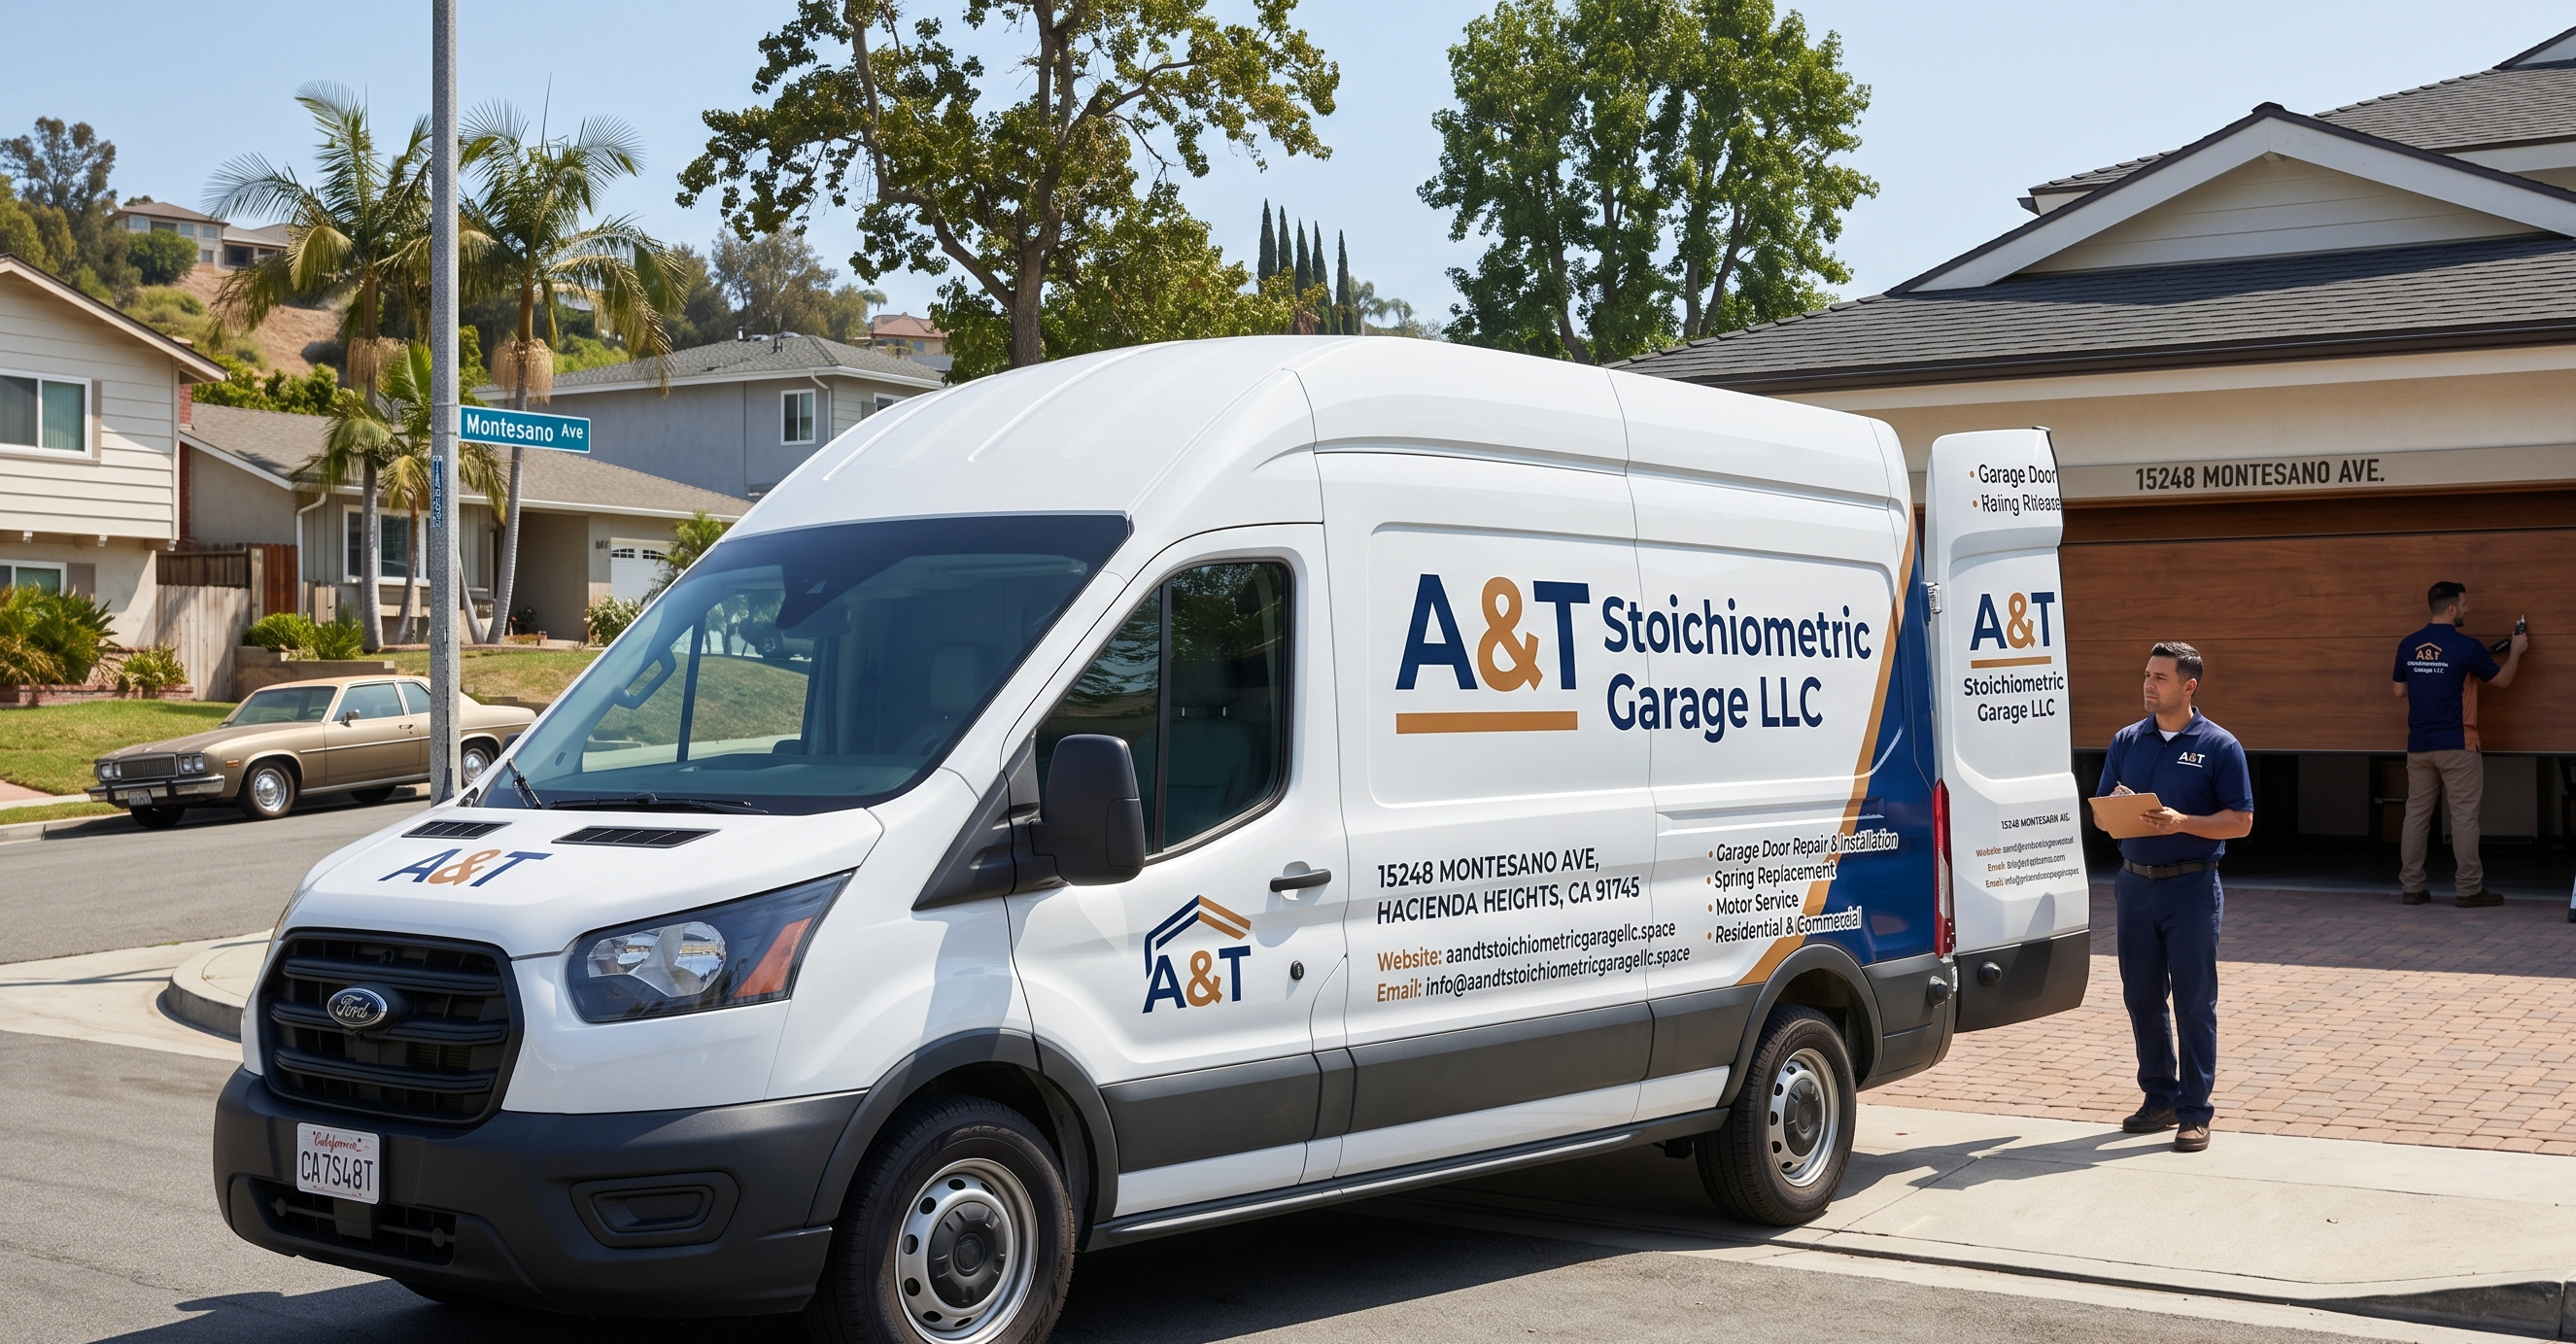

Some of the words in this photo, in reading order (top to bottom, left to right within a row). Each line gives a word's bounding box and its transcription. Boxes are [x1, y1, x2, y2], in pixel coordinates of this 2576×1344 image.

[466, 413, 554, 442] Montesano
[561, 423, 583, 439] Ave
[1978, 464, 2026, 488] Garage
[2028, 465, 2056, 484] Door
[2135, 466, 2195, 491] 15248
[2203, 461, 2330, 489] MONTESANO
[2338, 458, 2385, 483] AVE.
[1395, 573, 1591, 693] A&T
[1602, 593, 1872, 660] Stoichiometric
[1970, 591, 2055, 651] A&T
[1964, 671, 2064, 697] Stoichiometric
[1606, 672, 1749, 743] Garage
[1760, 676, 1823, 728] LLC
[1977, 703, 2028, 725] Garage
[2031, 698, 2055, 718] LLC
[2179, 751, 2206, 764] A&T
[377, 848, 554, 887] A&T
[1377, 860, 1434, 888] 15248
[1439, 850, 1558, 883] MONTESANO
[1561, 846, 1600, 874] AVE,
[1716, 843, 1760, 865] Garage
[1762, 839, 1791, 858] Door
[1793, 835, 1829, 859] Repair
[1831, 836, 1838, 852] &
[1714, 867, 1754, 892] Spring
[1758, 861, 1836, 888] Replacement
[1377, 891, 1479, 924] HACIENDA
[1484, 883, 1564, 913] HEIGHTS,
[1567, 881, 1593, 905] CA
[1595, 876, 1640, 902] 91745
[1715, 897, 1752, 916] Motor
[1755, 890, 1799, 912] Service
[1377, 947, 1443, 972] Website:
[1446, 922, 1676, 964] aandtstoichiometricgaragellc.space
[1715, 916, 1783, 944] Residential
[1786, 916, 1794, 934] &
[1142, 945, 1252, 1014] A&T
[1377, 979, 1423, 1003] Email:
[1425, 947, 1691, 997] info@aandtstoichiometricgaragellc.space
[335, 994, 371, 1018] Ford
[301, 1151, 374, 1191] CA7S48T
